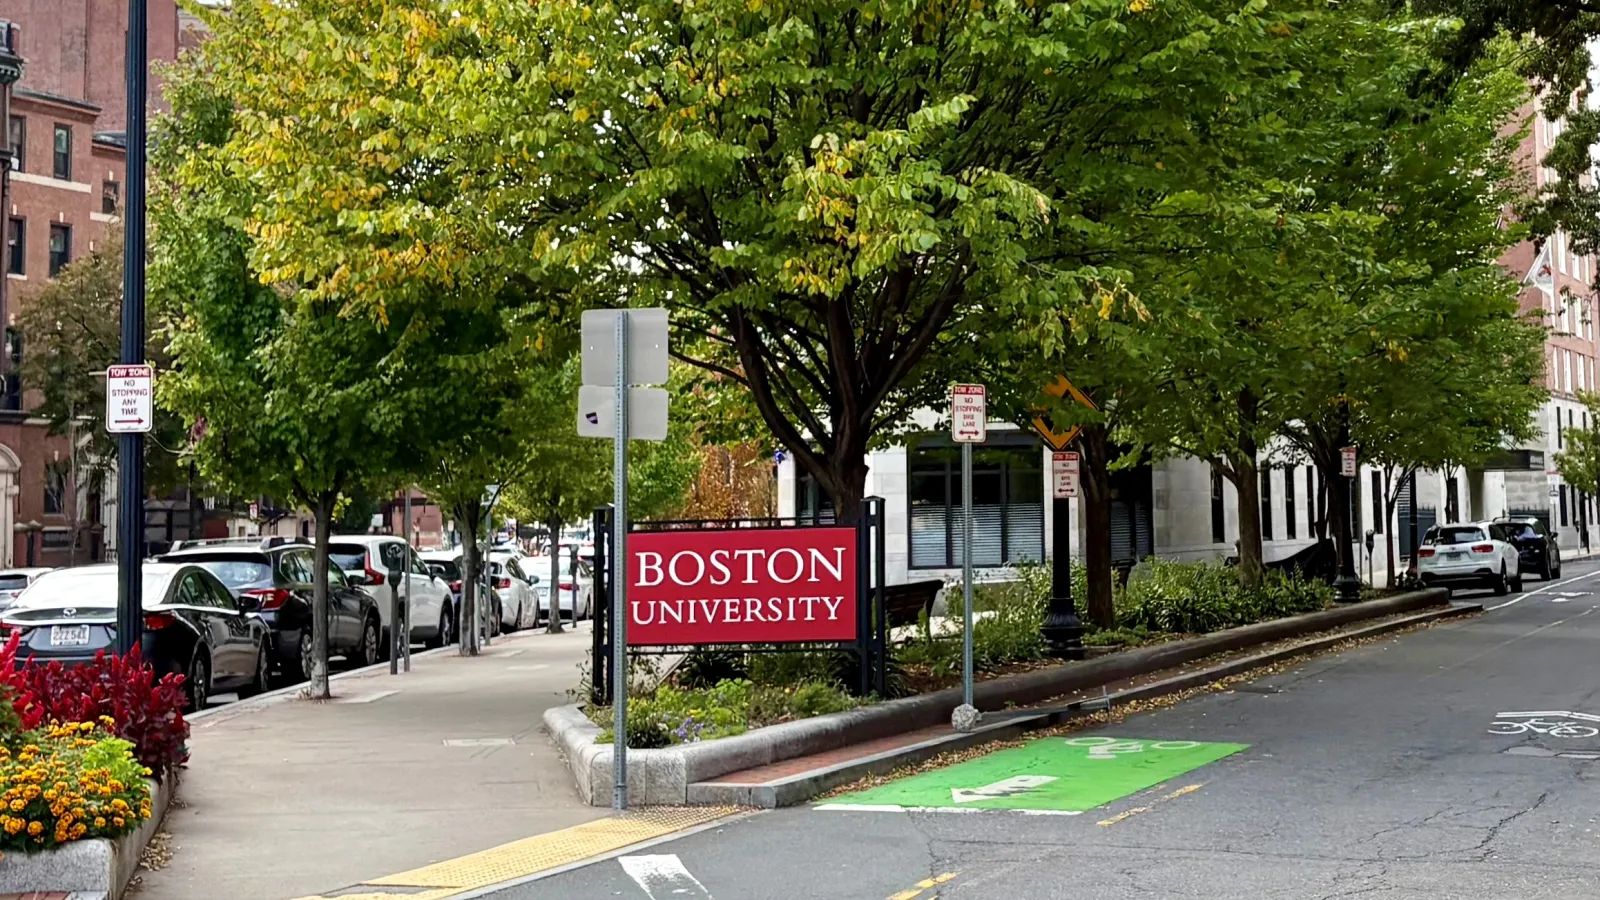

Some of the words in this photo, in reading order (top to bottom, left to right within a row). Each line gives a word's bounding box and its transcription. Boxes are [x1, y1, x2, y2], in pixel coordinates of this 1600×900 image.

[111, 368, 127, 377] TOW
[128, 368, 150, 377] ZONE
[124, 379, 136, 387] NO
[111, 388, 148, 397] STOPPING
[121, 408, 138, 416] TIME
[634, 546, 847, 587] BOSTON
[631, 596, 845, 626] UNIVERSITY
